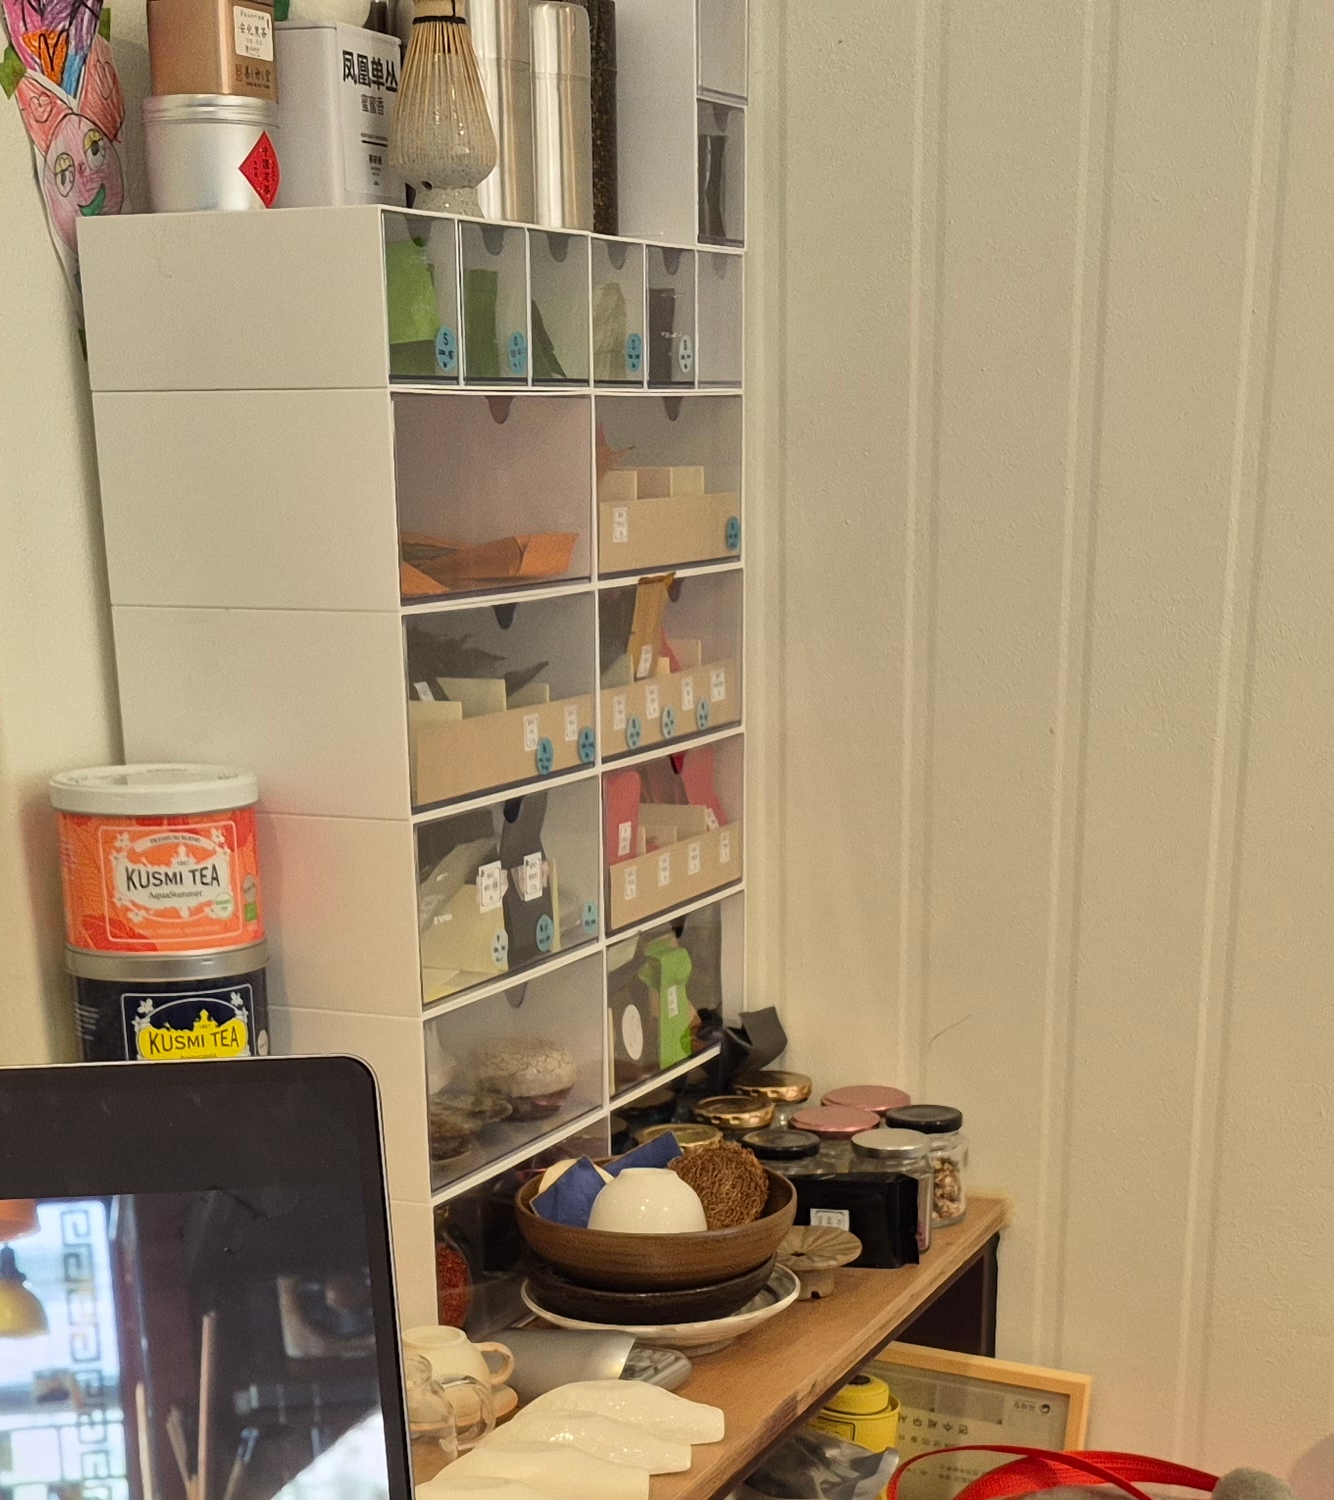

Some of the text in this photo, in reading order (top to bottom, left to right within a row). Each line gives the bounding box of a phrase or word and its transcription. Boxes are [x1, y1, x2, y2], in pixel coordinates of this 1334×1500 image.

[342, 50, 398, 93] 凤凰单丛
[125, 863, 221, 892] KUSMI TEA
[148, 1026, 240, 1055] KUSMI TEA
